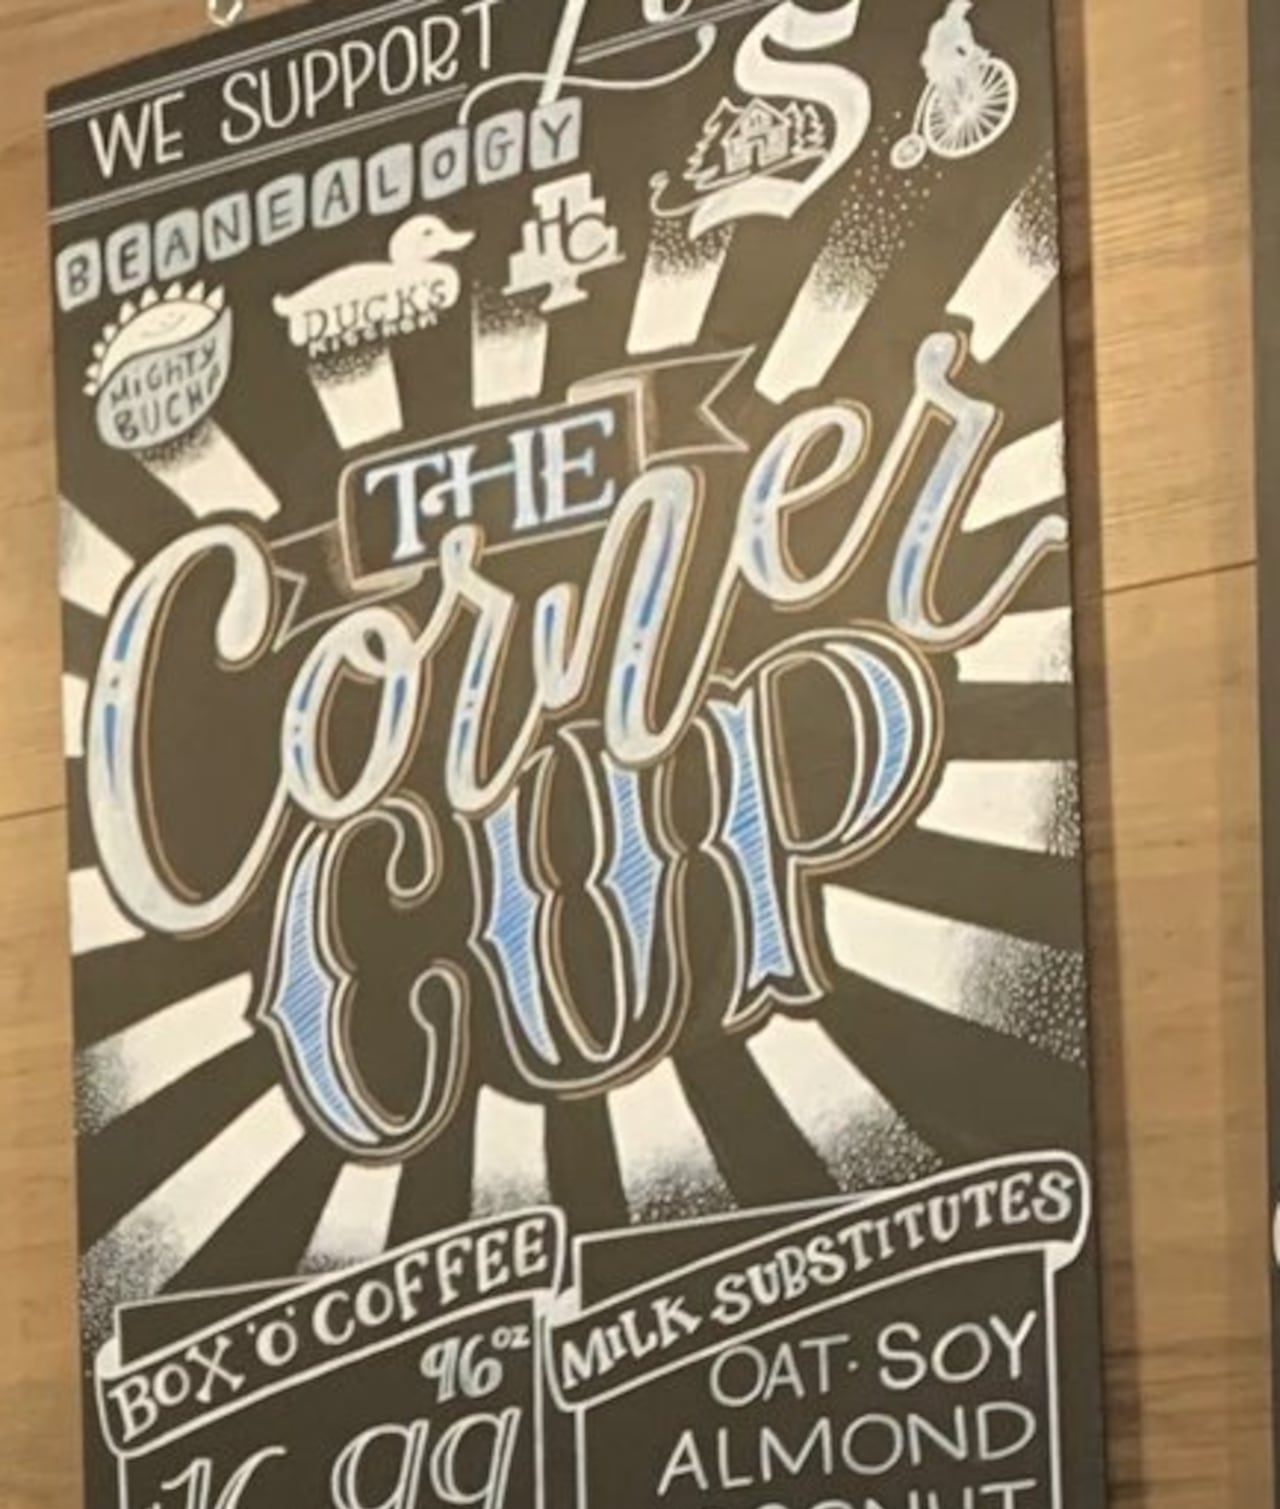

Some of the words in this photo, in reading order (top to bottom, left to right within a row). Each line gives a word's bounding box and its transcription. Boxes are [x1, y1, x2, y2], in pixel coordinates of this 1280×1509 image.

[88, 92, 185, 178] WE
[220, 2, 497, 146] SUPPORT
[57, 102, 581, 304] BEANEALOGY
[364, 406, 617, 563] THE
[85, 333, 1068, 938] Corner
[255, 622, 948, 1160] CUP
[105, 1333, 244, 1442] BOX
[311, 1213, 552, 1345] COFFEE
[559, 1290, 704, 1390] MILK
[713, 1166, 1076, 1327] SUBSTITUTES
[877, 1309, 1038, 1392] SOY
[656, 1398, 1038, 1500] ALMOND
